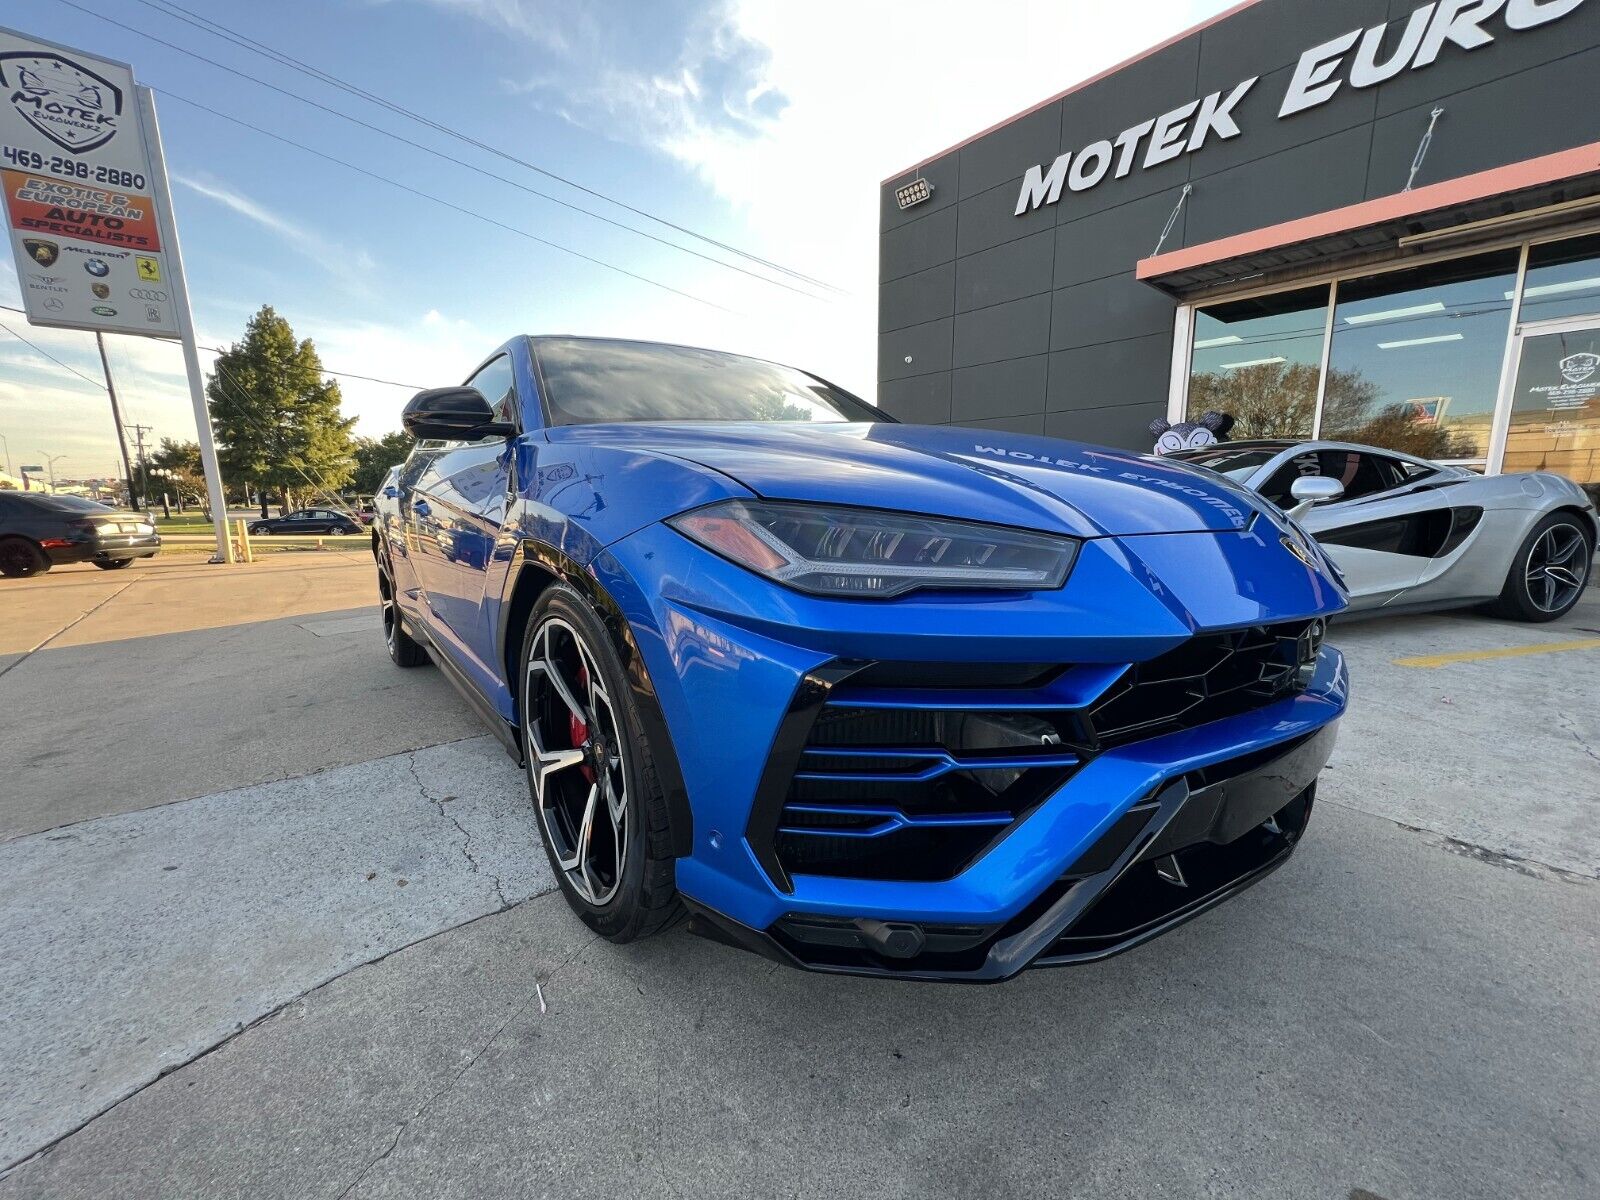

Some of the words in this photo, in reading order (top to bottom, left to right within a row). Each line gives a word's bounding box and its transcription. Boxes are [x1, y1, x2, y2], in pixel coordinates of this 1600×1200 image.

[11, 91, 117, 127] MOTEK
[1015, 75, 1260, 216] MOTEK
[4, 146, 146, 190] 469-298-2880
[16, 187, 143, 220] EUROPEAN
[26, 178, 108, 201] EXOTIC
[20, 216, 149, 246] SPECIALISTS
[45, 207, 124, 231] AUTO
[29, 283, 70, 294] BENTLEY
